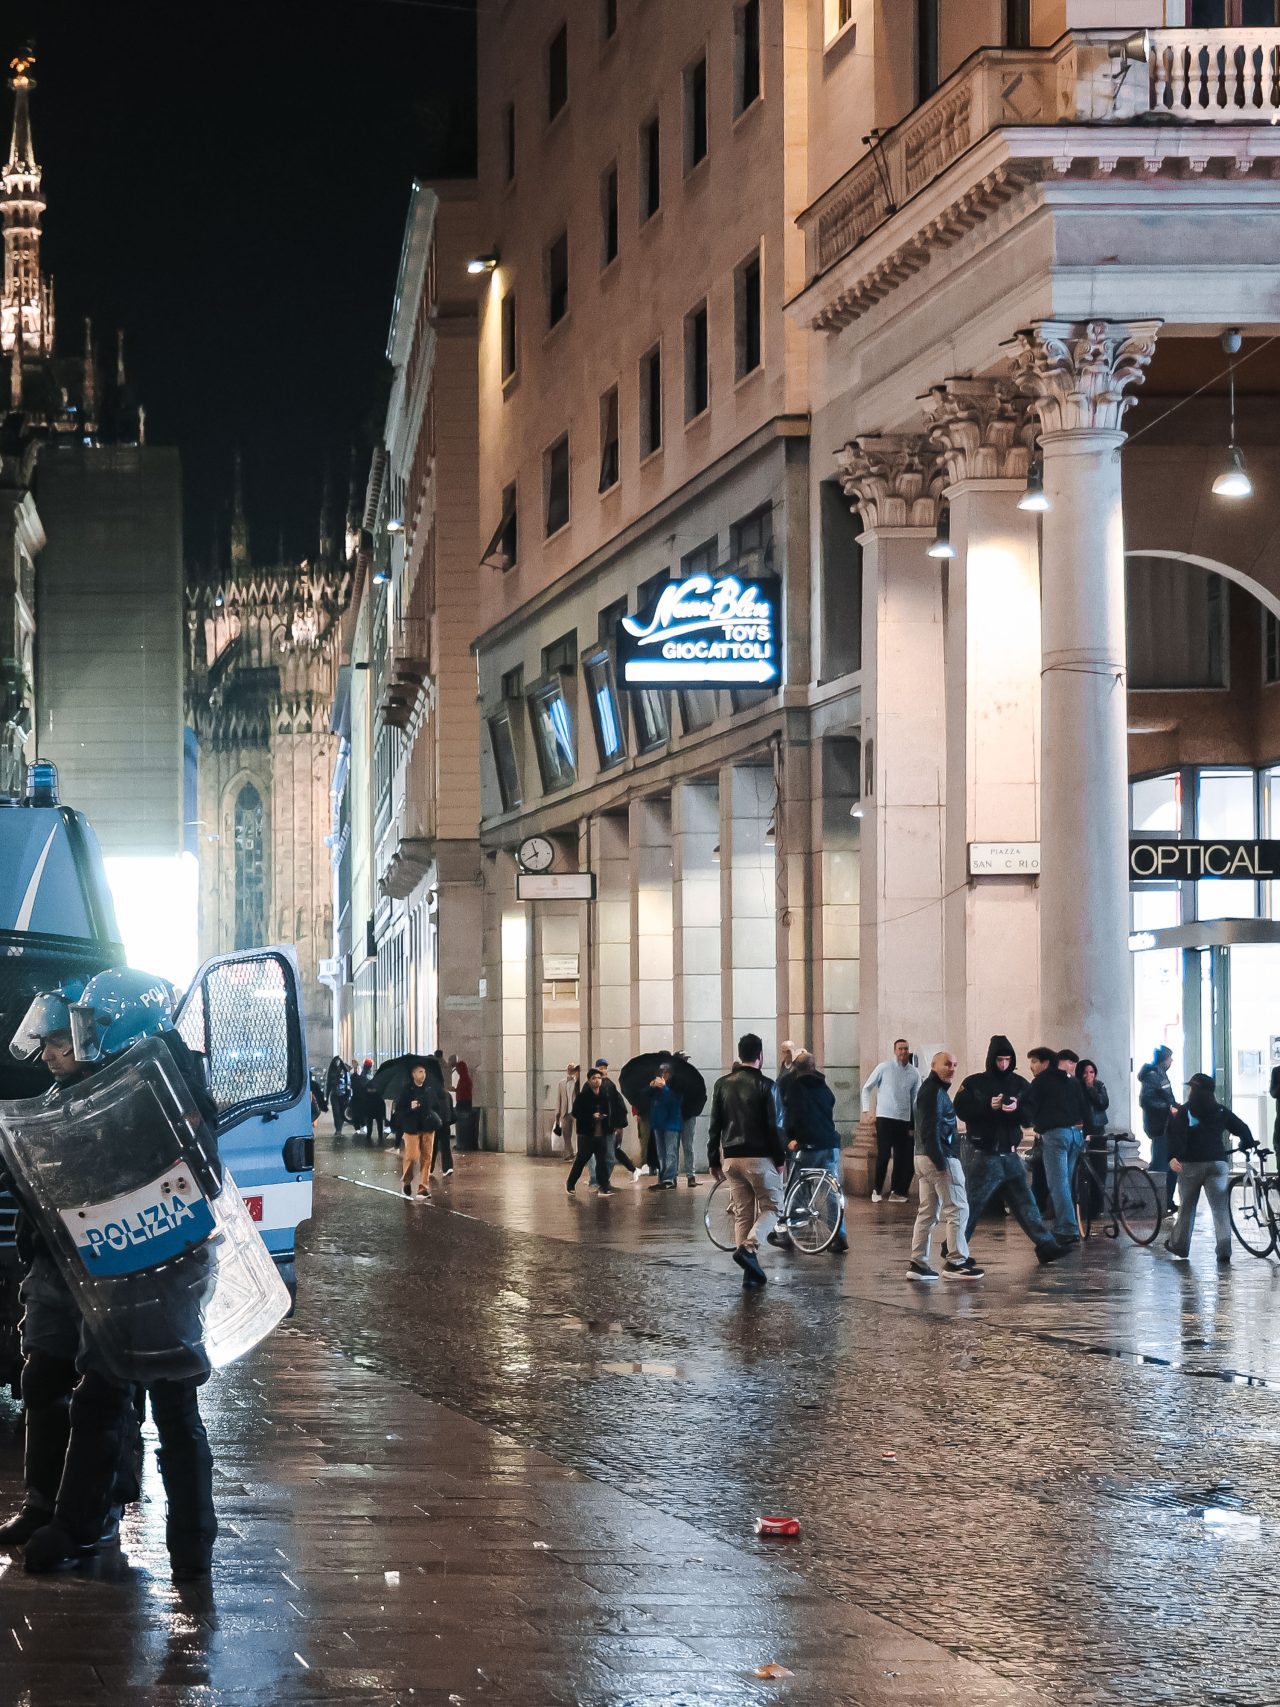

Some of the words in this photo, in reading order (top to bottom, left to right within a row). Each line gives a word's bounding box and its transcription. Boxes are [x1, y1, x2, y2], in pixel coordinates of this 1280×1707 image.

[722, 625, 771, 641] TOYS
[662, 642, 771, 659] GIOCATTOLI
[972, 861, 992, 869] SAN
[1004, 860, 1039, 868] CRO
[1131, 845, 1274, 875] OPTICAL
[86, 1195, 195, 1257] POLIZIA
